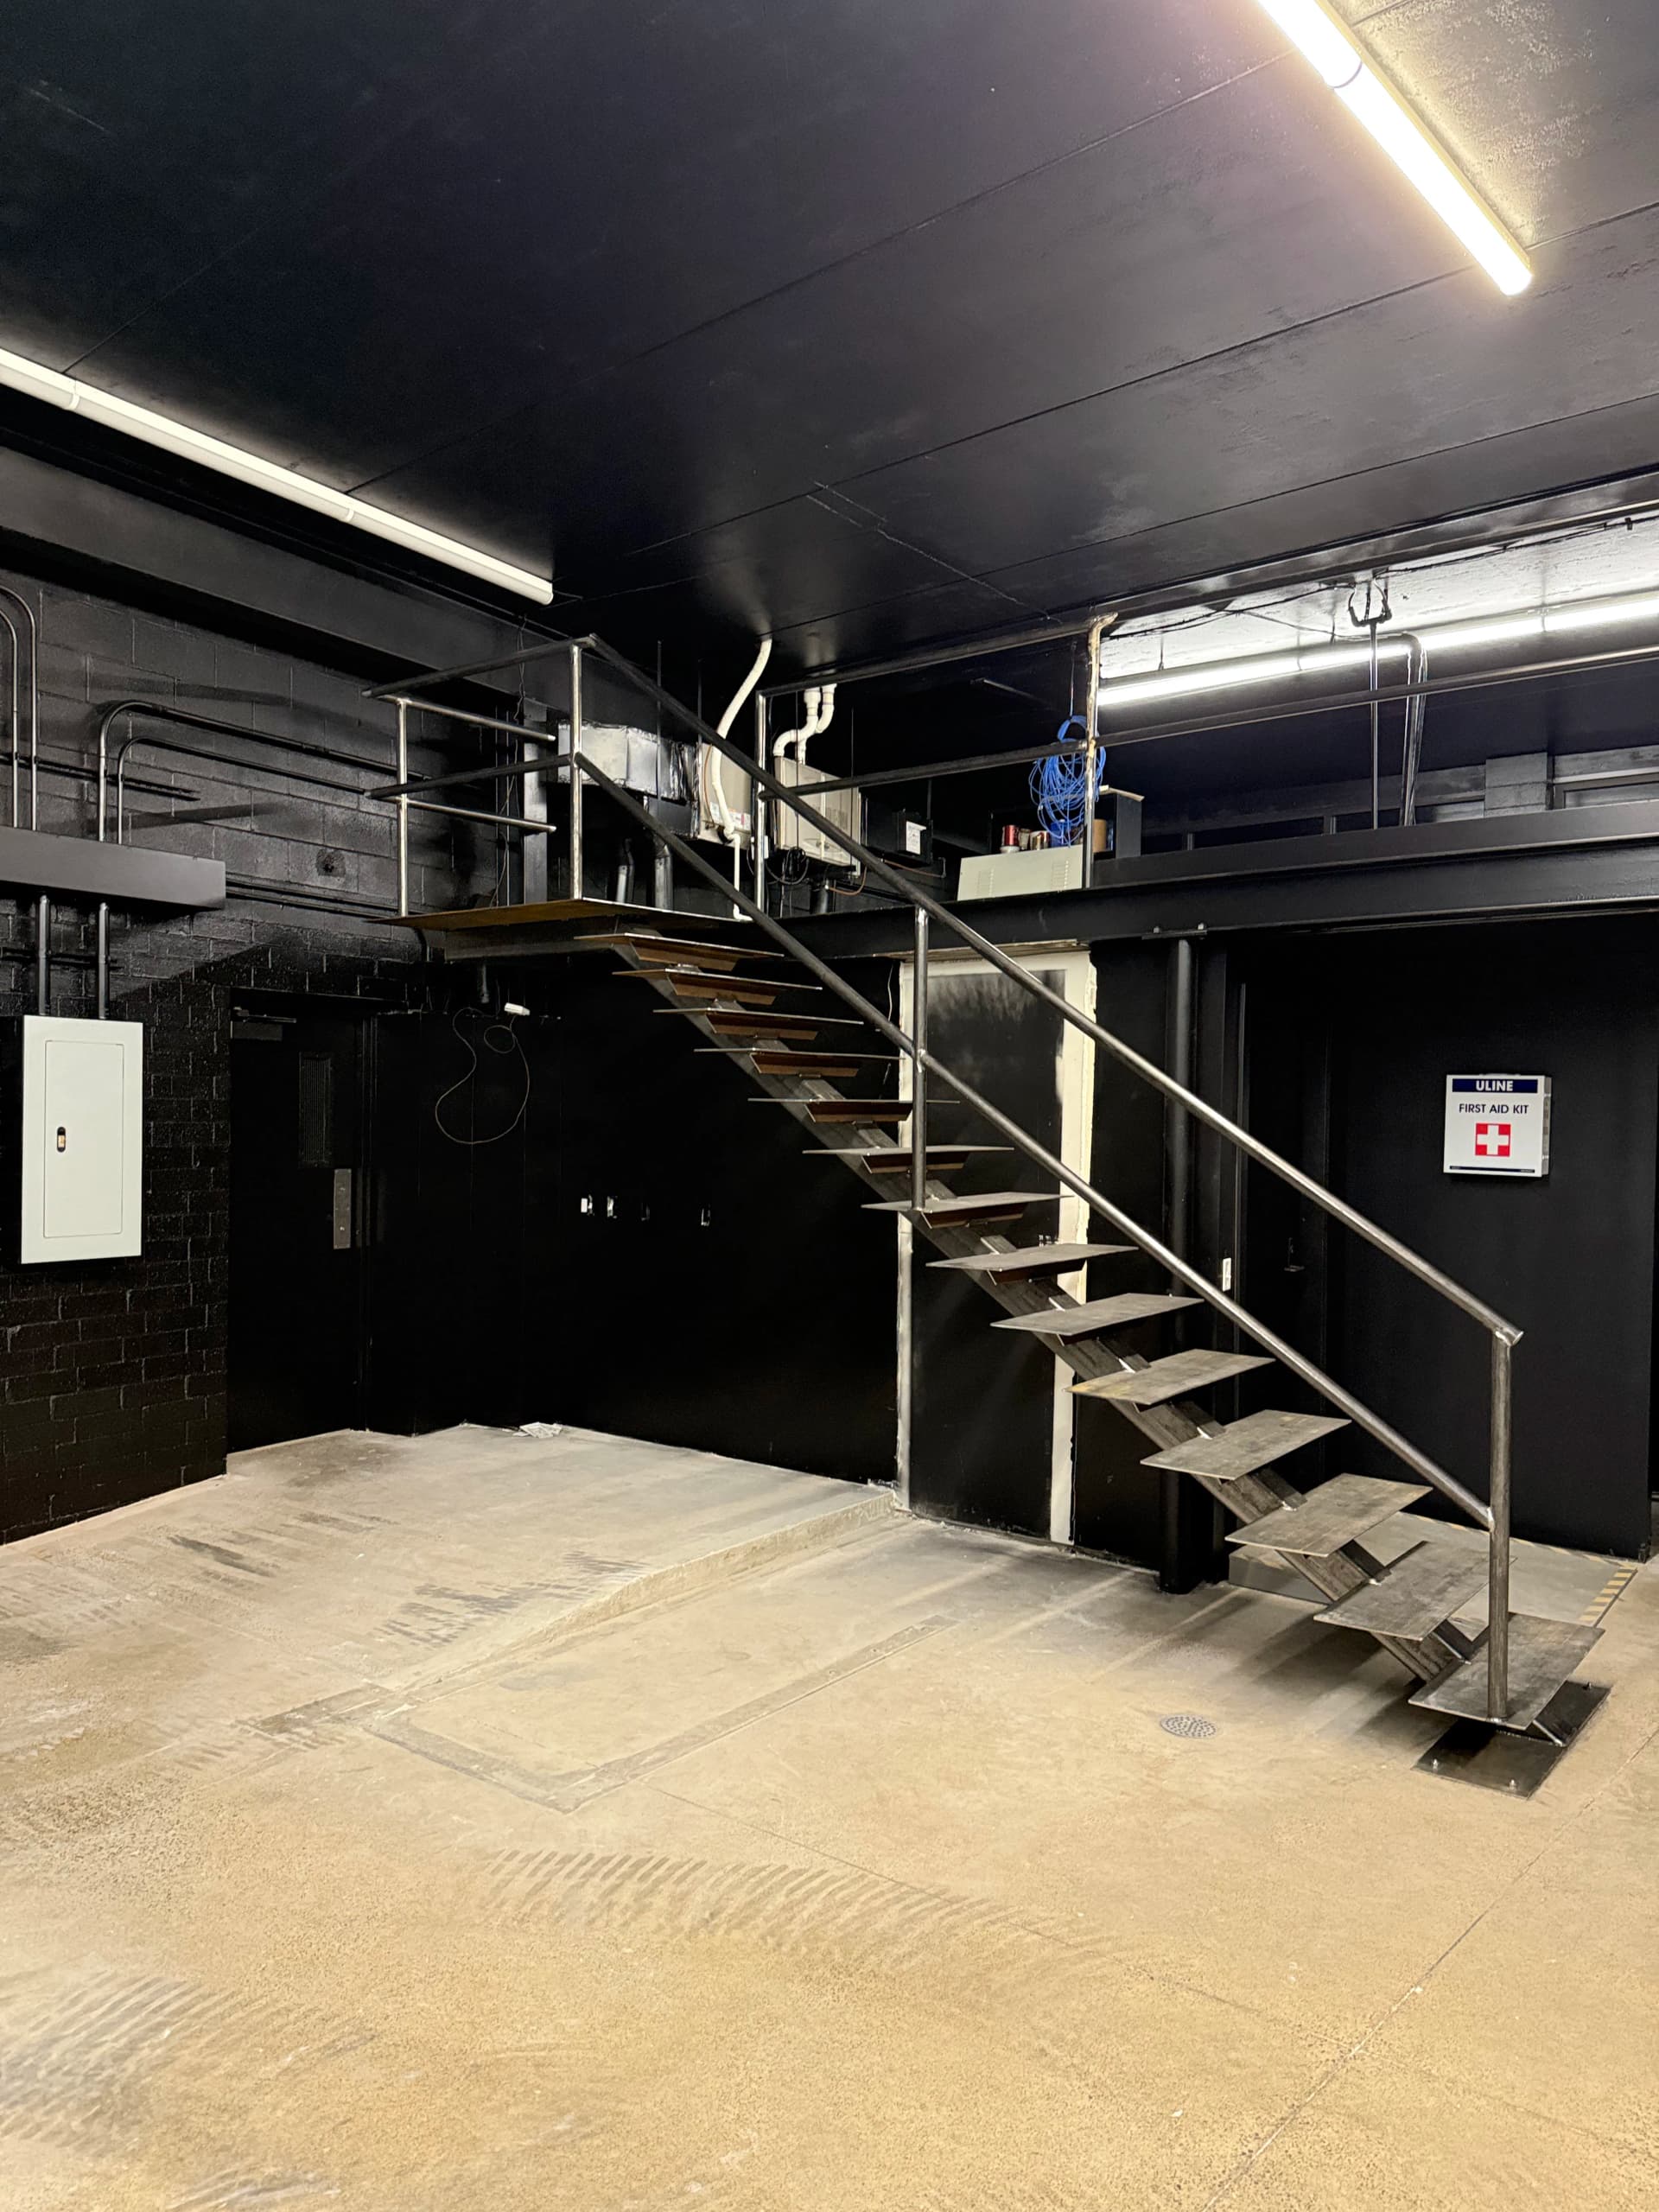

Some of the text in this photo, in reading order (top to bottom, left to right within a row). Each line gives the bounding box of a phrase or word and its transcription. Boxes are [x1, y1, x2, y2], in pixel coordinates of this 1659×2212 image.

[1476, 1080, 1514, 1091] ULINE
[1459, 1103, 1529, 1114] FIRST AID KIT
